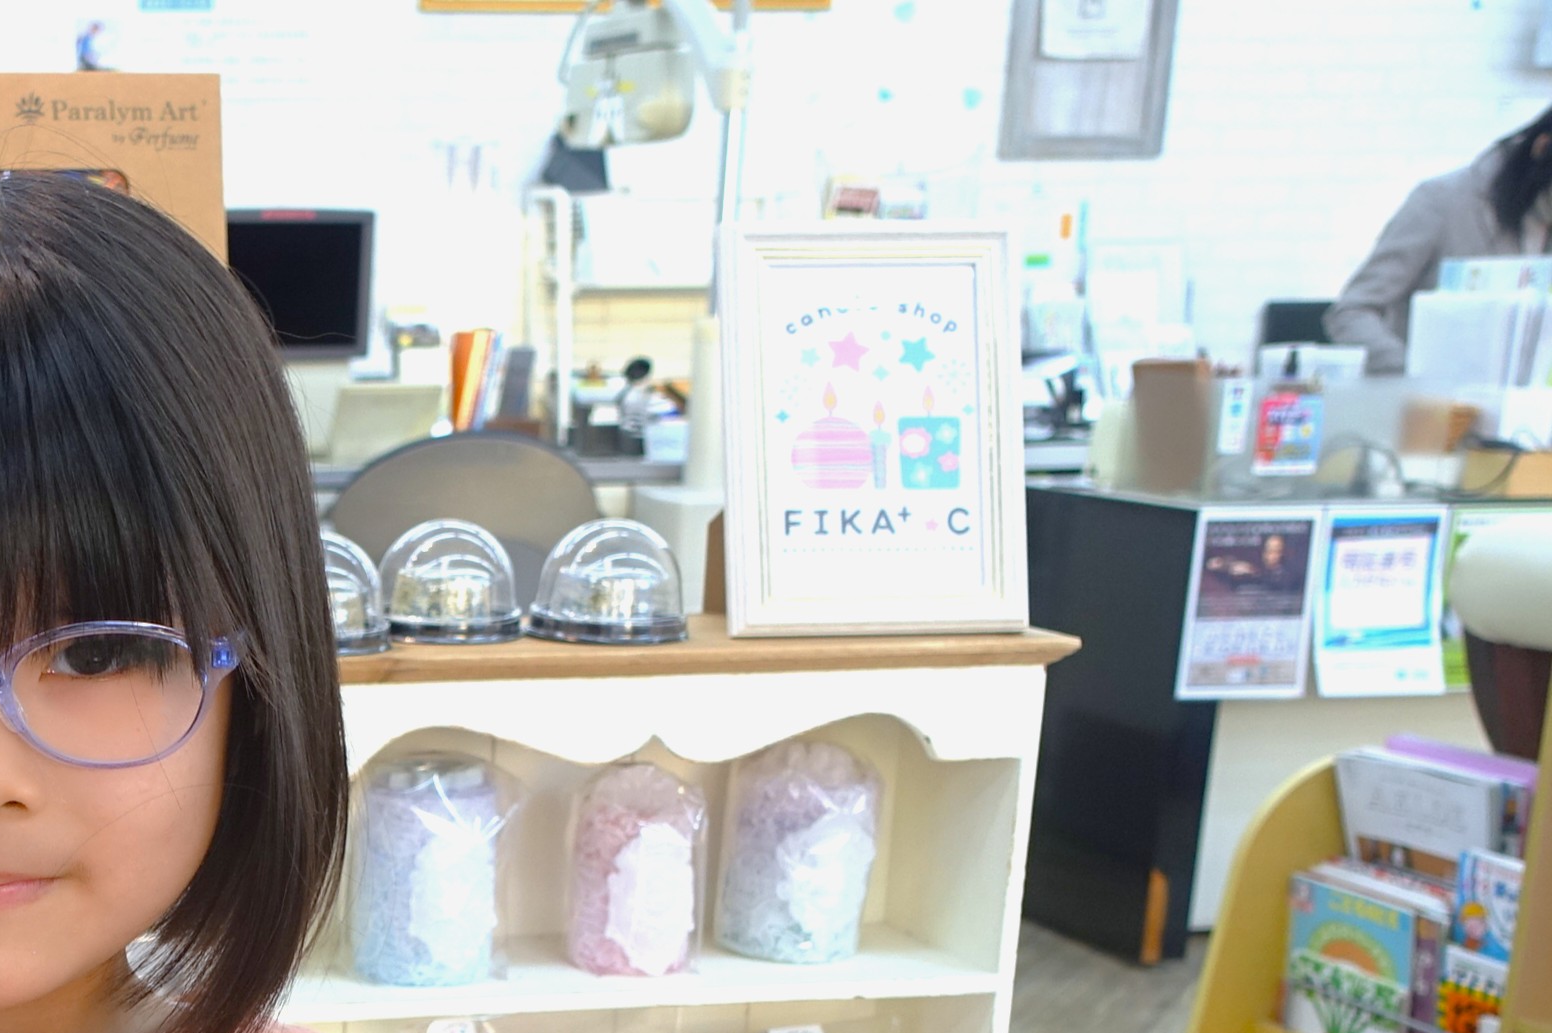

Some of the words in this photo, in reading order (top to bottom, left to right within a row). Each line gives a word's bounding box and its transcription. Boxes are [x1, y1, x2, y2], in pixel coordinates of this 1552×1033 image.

[51, 98, 153, 125] Paralym
[159, 100, 200, 122] Art
[898, 302, 958, 334] shop
[947, 507, 971, 535] C
